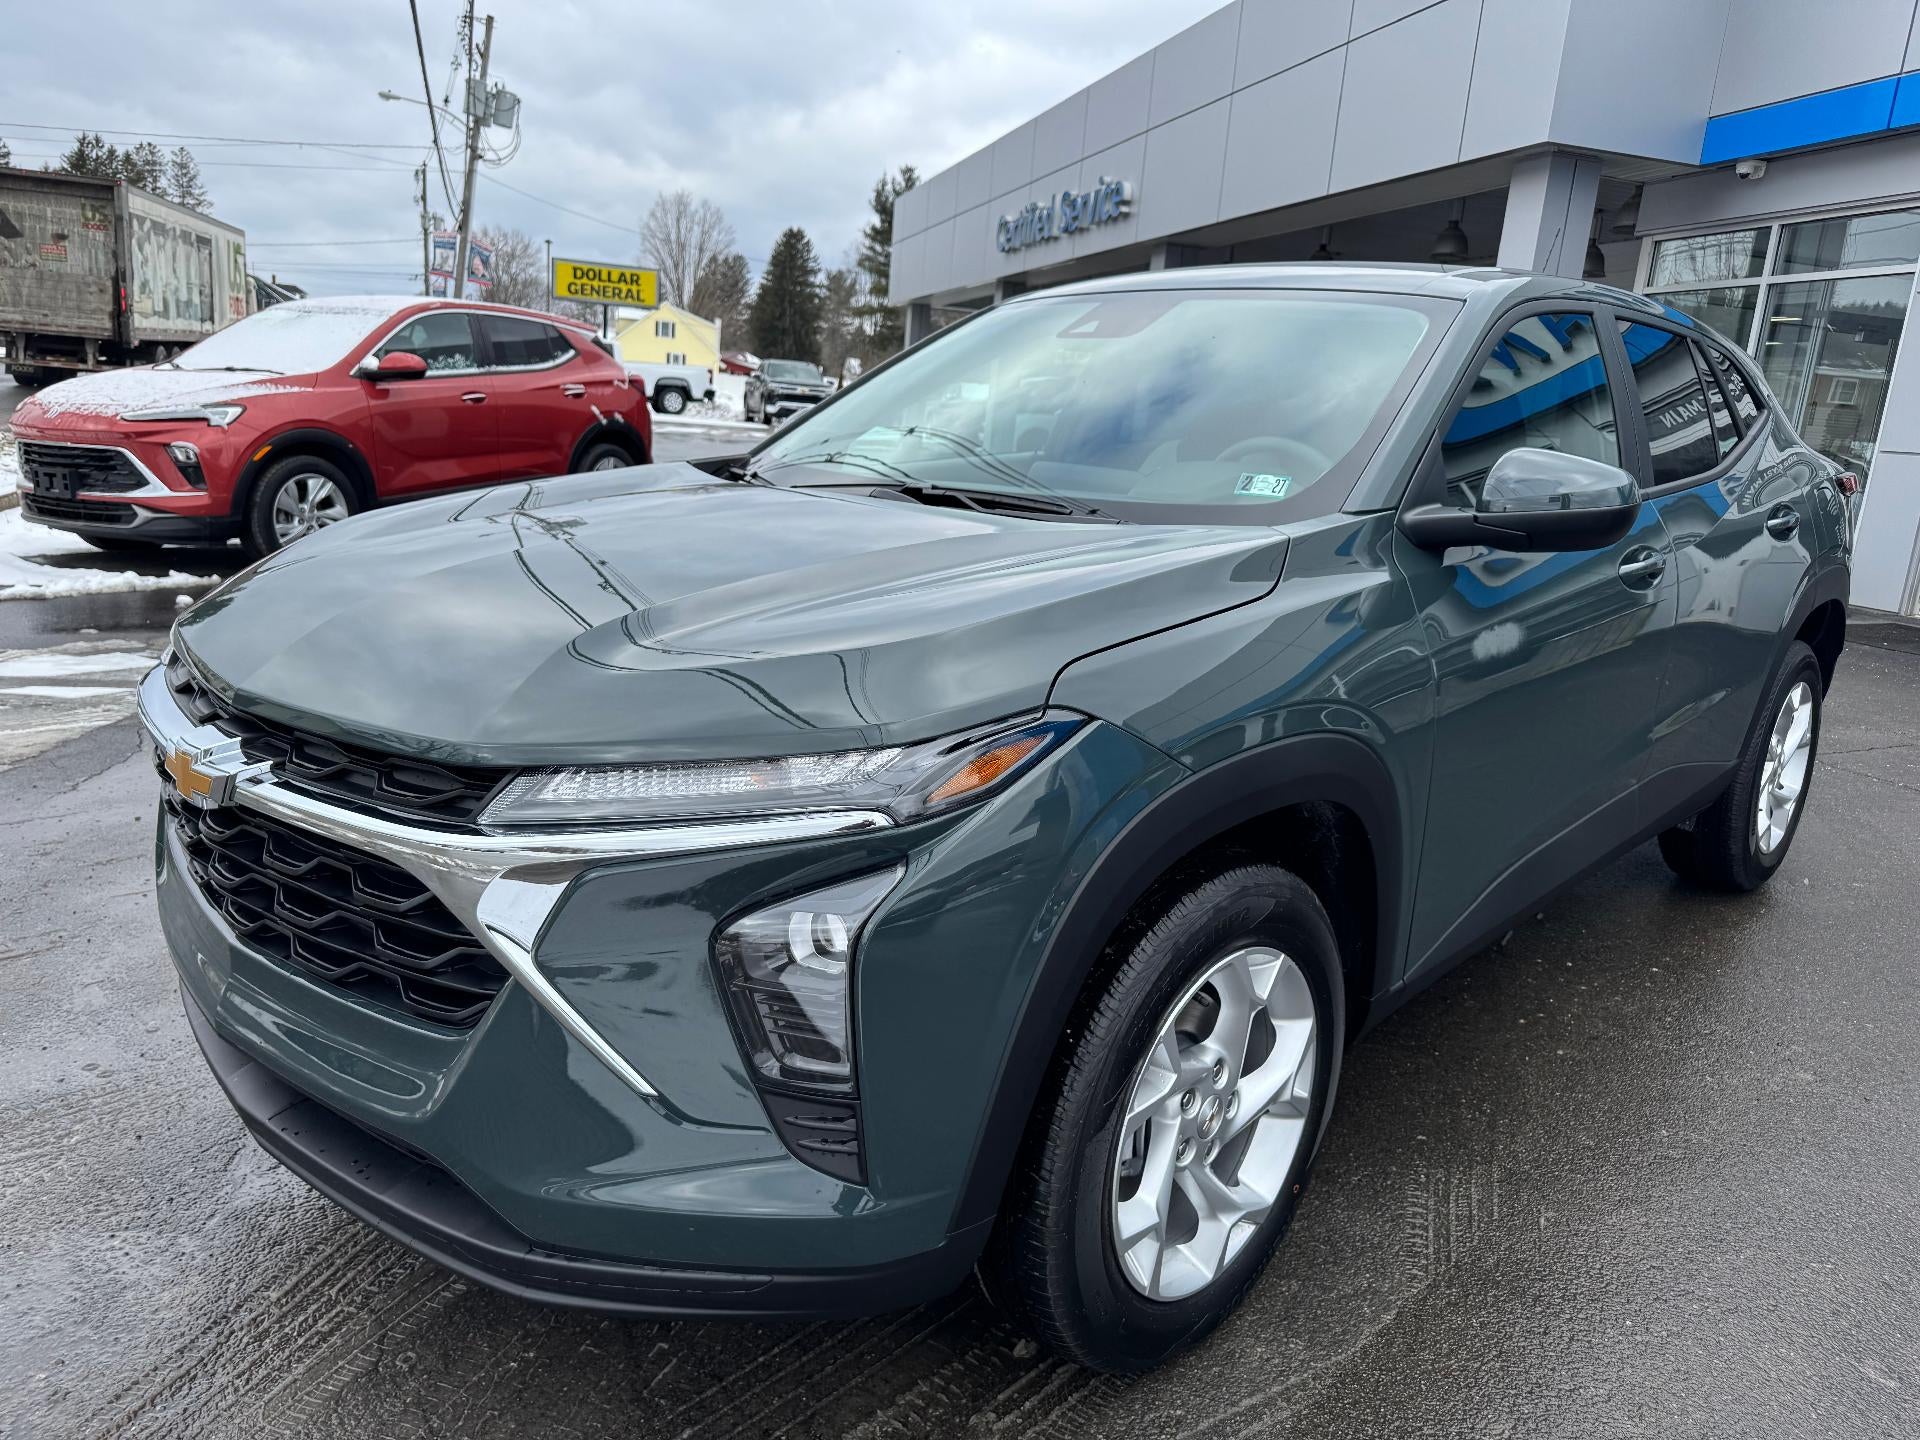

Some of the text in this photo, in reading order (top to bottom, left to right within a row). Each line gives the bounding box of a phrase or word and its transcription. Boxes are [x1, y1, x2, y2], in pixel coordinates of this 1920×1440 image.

[997, 176, 1133, 253] Certified Service
[573, 266, 640, 286] DOLLAR
[567, 282, 645, 302] GENERAL
[1241, 475, 1254, 492] 2
[1272, 478, 1287, 494] 27
